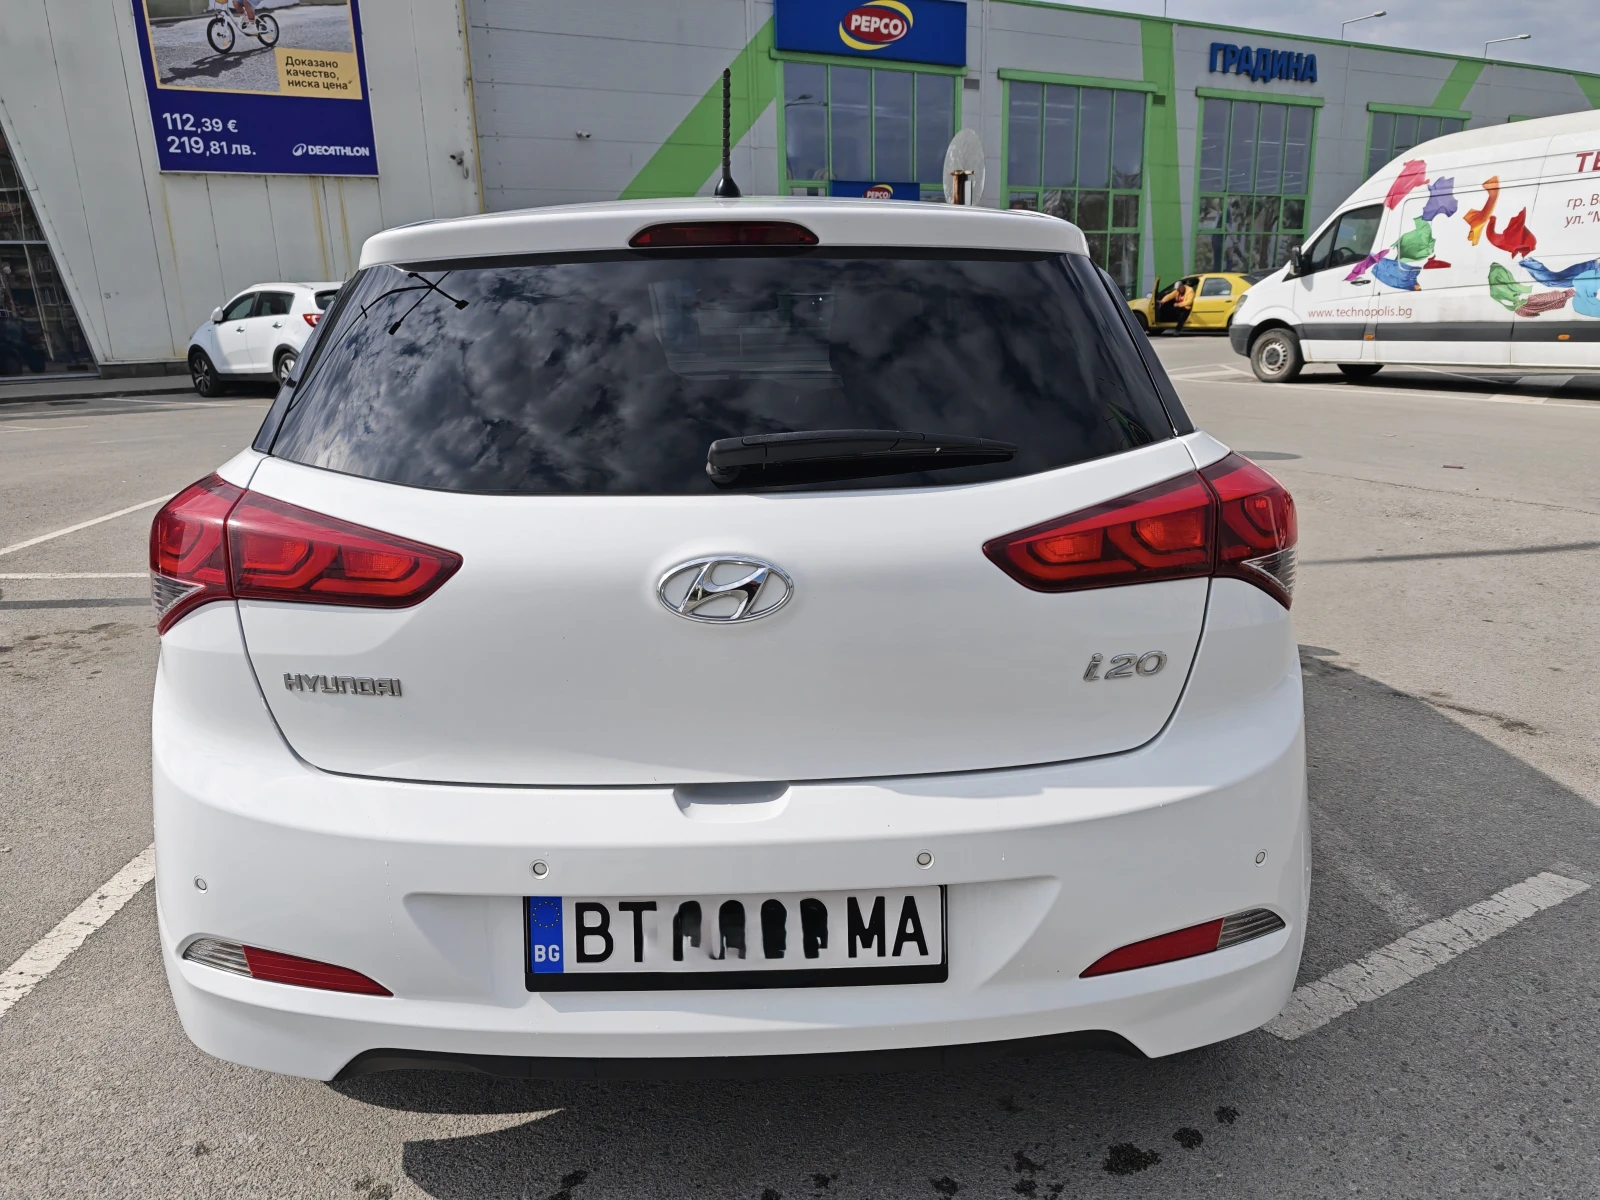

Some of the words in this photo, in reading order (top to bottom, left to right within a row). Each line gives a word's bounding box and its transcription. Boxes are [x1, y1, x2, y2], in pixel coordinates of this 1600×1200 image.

[850, 14, 903, 36] PEPCO
[285, 56, 339, 69] Доказано
[1209, 42, 1318, 83] ГРАДИНА
[286, 68, 340, 81] качество,
[287, 79, 320, 89] ниска
[162, 112, 223, 134] 112,39
[227, 119, 239, 133] €
[166, 135, 228, 157] 219,81
[231, 143, 257, 156] лв.
[307, 145, 370, 157] DECATHLON
[866, 190, 889, 199] PEPCO
[1566, 197, 1586, 211] гр.
[1589, 193, 1600, 206] В
[1563, 214, 1585, 228] ул.
[1083, 650, 1168, 682] i20
[283, 672, 402, 697] HYUNDAI
[534, 944, 560, 963] BG
